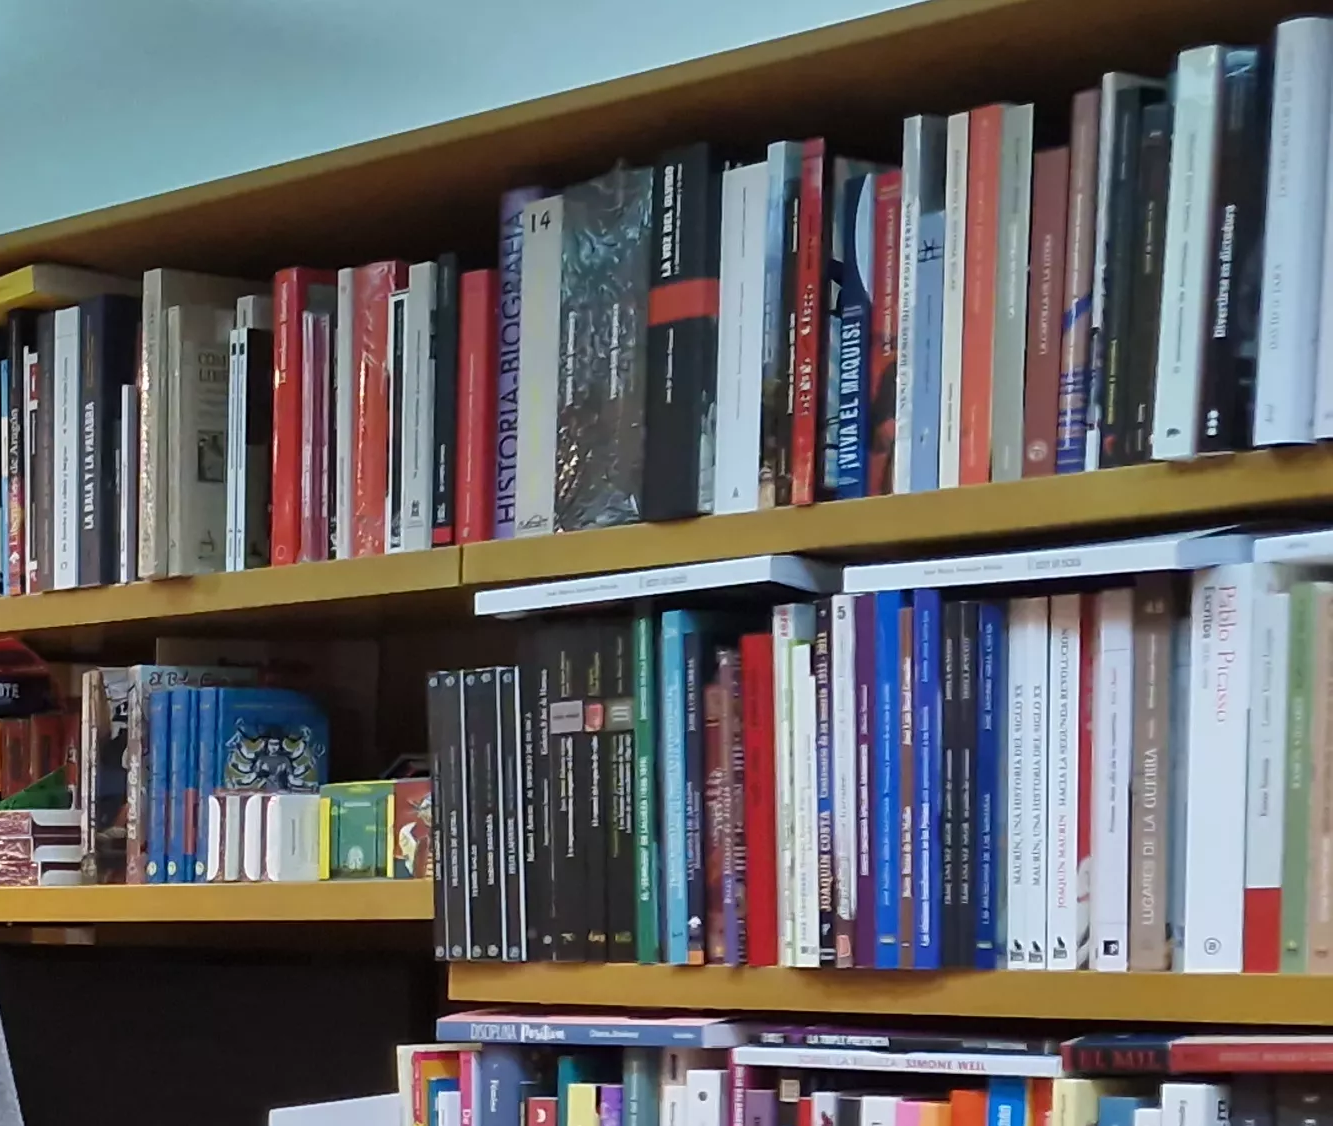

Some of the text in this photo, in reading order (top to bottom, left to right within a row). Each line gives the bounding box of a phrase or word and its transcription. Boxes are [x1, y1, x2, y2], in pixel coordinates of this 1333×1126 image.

[842, 323, 861, 394] MAQUIS!
[840, 397, 856, 419] EL
[85, 454, 95, 470] LA
[84, 512, 94, 530] LA
[1142, 815, 1155, 832] LA
[1141, 837, 1154, 856] DE
[1141, 861, 1154, 925] LUGARES
